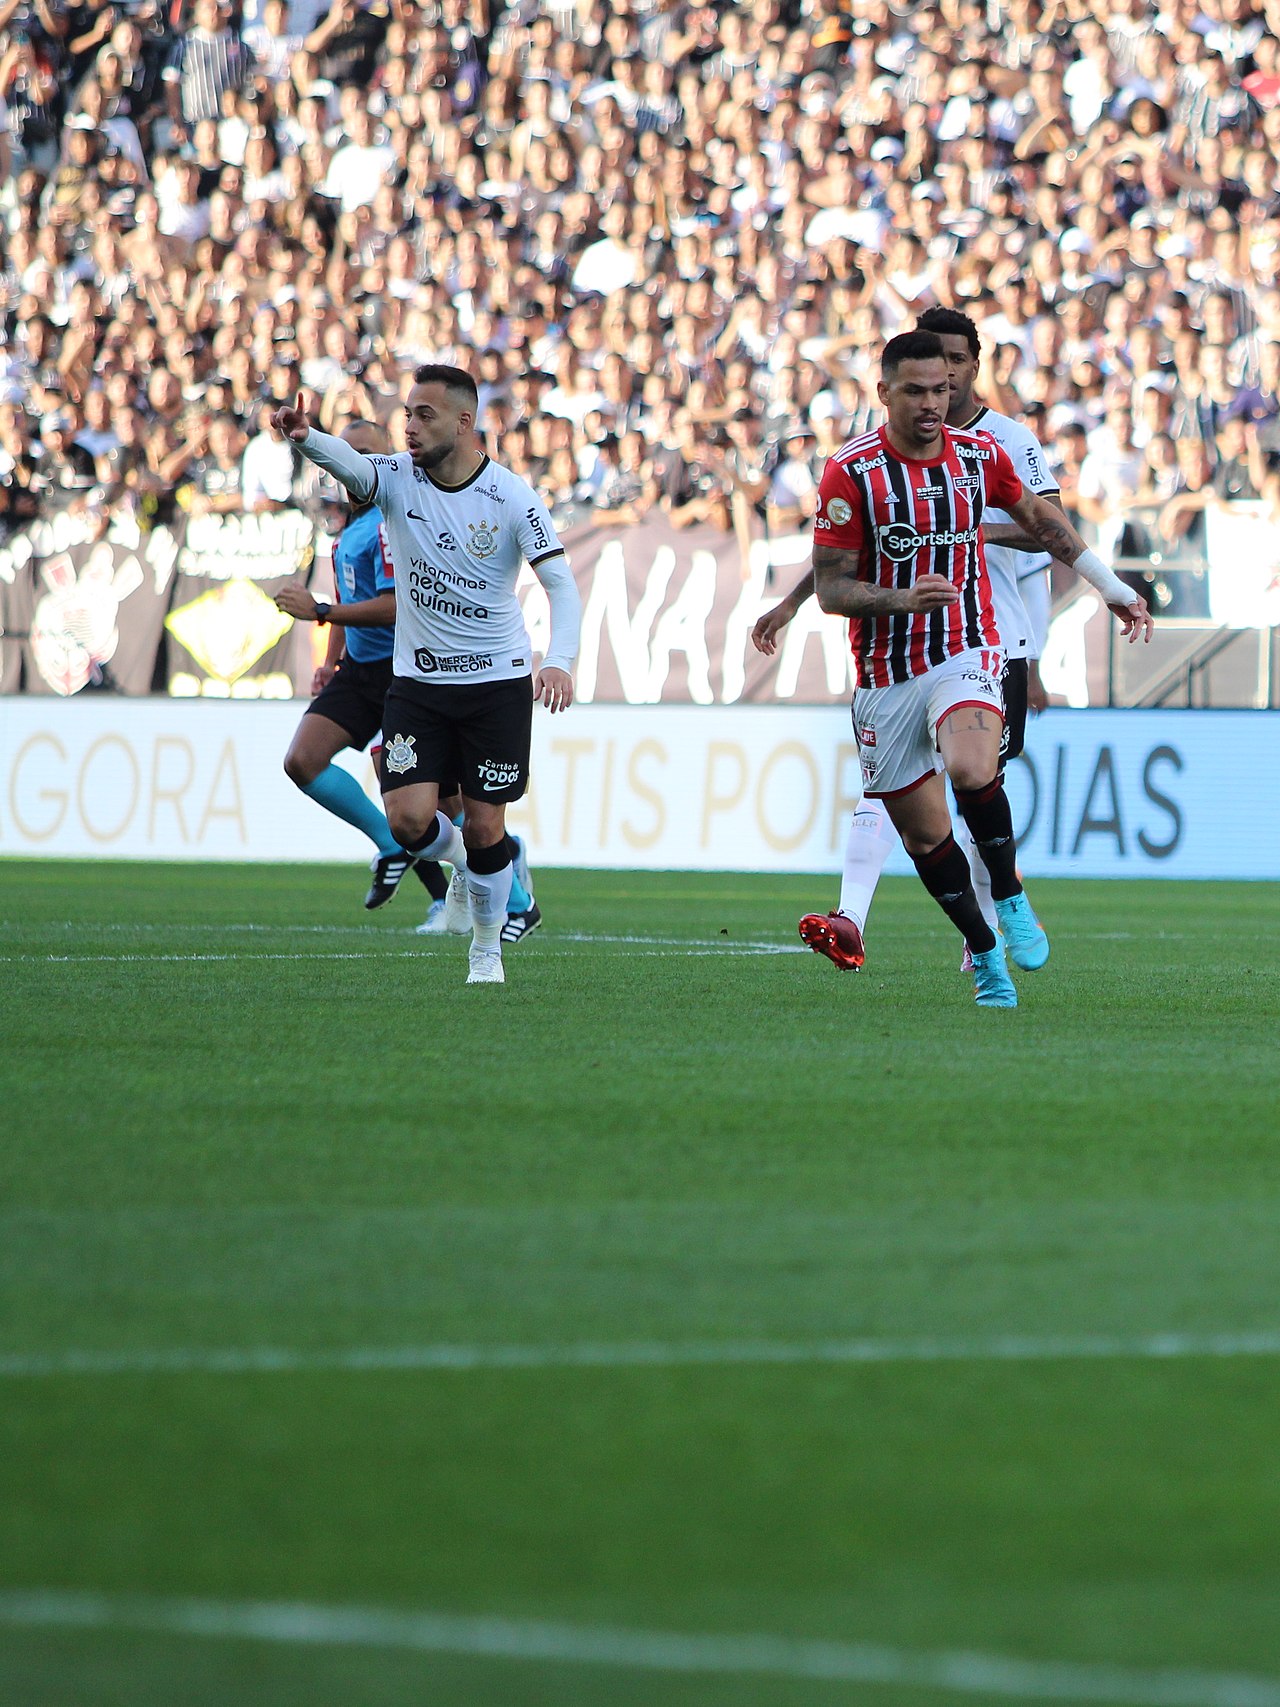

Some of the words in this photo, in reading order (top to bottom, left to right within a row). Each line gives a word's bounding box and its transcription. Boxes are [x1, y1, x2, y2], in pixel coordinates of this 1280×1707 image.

[853, 453, 888, 475] Roku
[956, 445, 990, 460] Roku
[956, 477, 978, 487] SPFC
[1028, 456, 1043, 486] bmg
[529, 515, 549, 550] bmg
[409, 571, 448, 595] neo
[410, 556, 488, 591] vitaminas
[409, 588, 489, 620] química
[439, 659, 494, 673] BITCOIN
[477, 765, 520, 784] TODOS
[485, 758, 512, 770] Cartão
[0, 730, 248, 844] GORA
